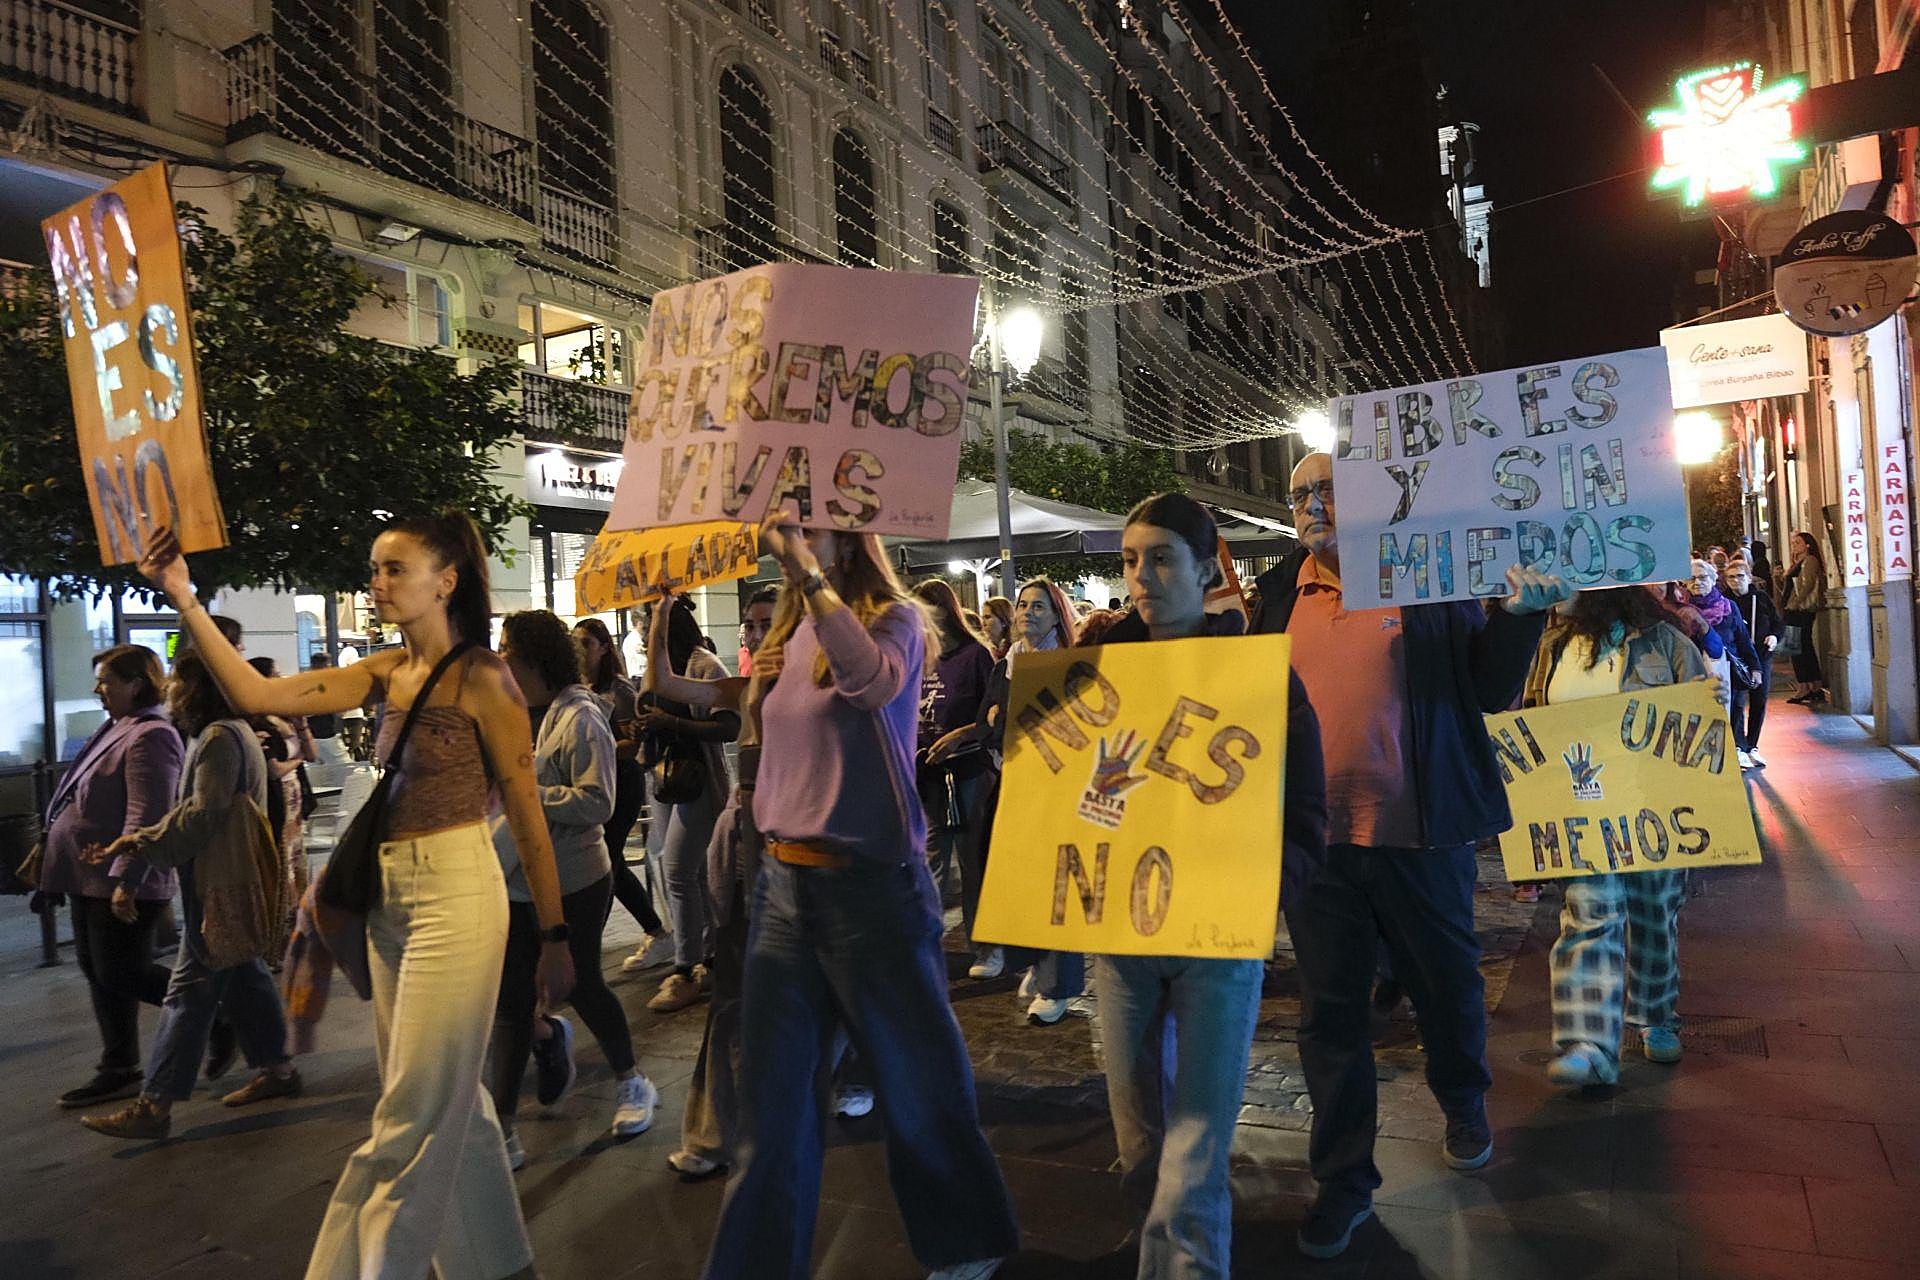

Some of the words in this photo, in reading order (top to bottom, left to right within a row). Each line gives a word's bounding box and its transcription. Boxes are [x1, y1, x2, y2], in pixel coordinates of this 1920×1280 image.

[47, 192, 139, 338] NO
[651, 275, 773, 365] NOS
[90, 303, 184, 442] ES
[630, 341, 969, 442] QUEREMOS
[1337, 362, 1621, 462] LIBRES
[1766, 369, 1794, 380] Bilbao
[93, 438, 180, 564] NO
[657, 442, 885, 529] VIVAS
[1384, 460, 1430, 525] Y
[1490, 438, 1627, 511] SIN
[1847, 474, 1865, 576] FARMACIA
[1884, 446, 1908, 569] FARMACIA
[580, 523, 758, 614] CALLADA
[1378, 511, 1657, 599] MIEDOS
[1017, 660, 1120, 775] NO
[1144, 695, 1261, 805] ES
[1491, 716, 1547, 785] NI
[1620, 698, 1727, 775] UNA
[1528, 806, 1711, 872] MENOS
[1050, 842, 1174, 937] NO
